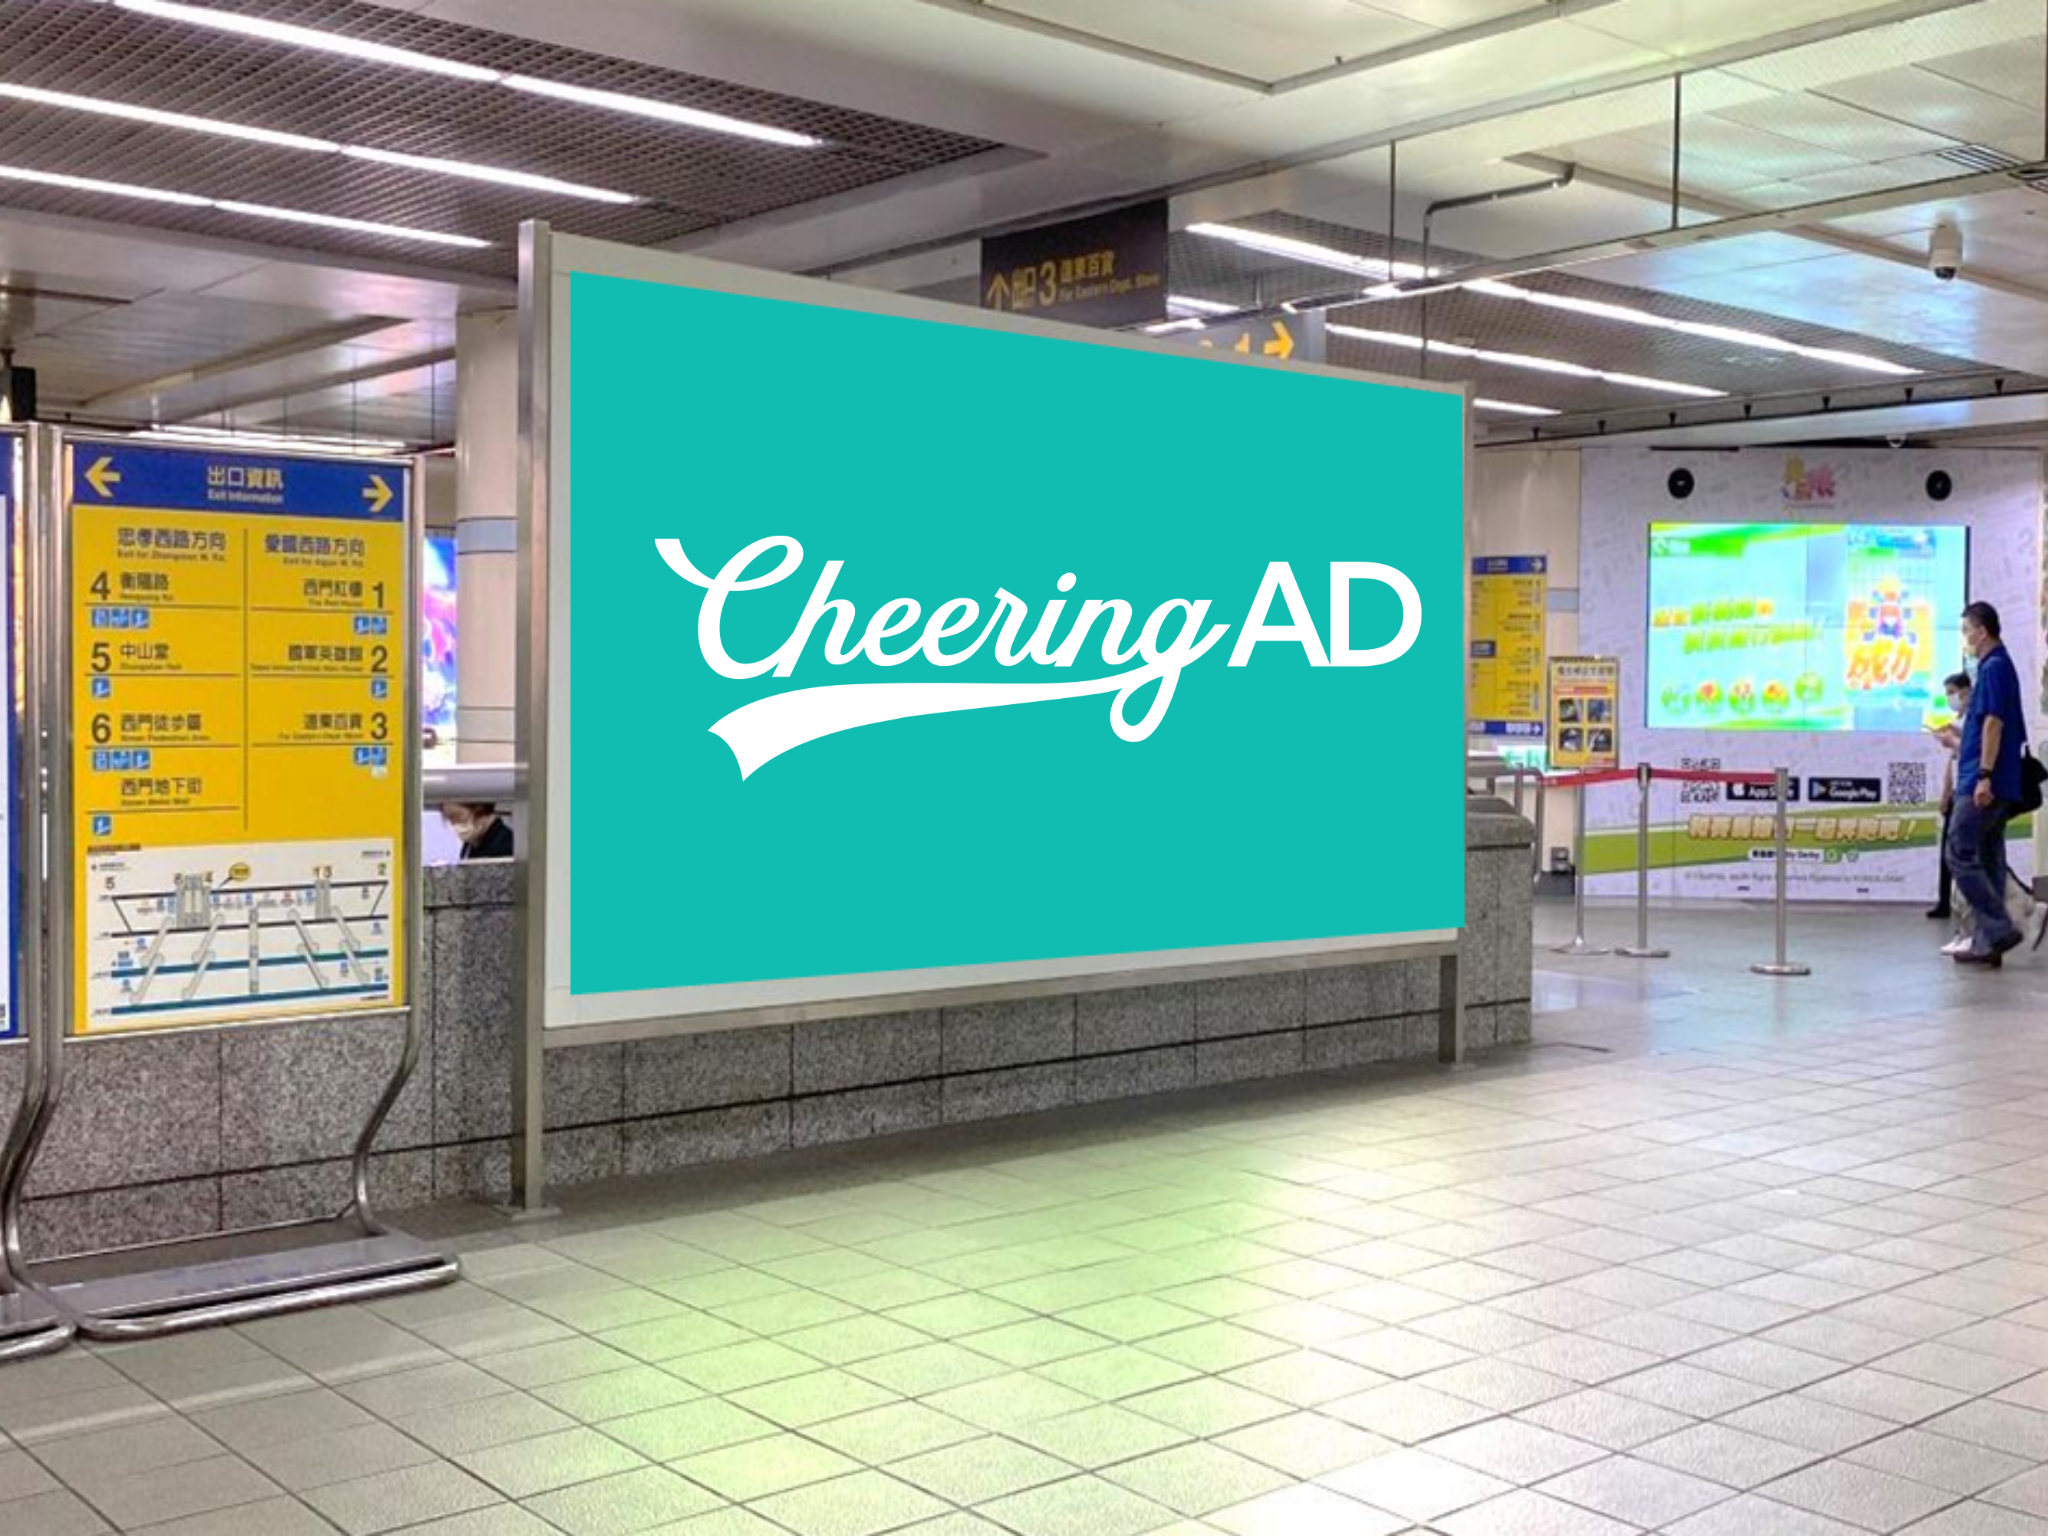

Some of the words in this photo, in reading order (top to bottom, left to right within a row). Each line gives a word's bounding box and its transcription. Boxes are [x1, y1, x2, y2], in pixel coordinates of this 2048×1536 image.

[1040, 262, 1056, 306] 3
[208, 466, 283, 490] 出口資訊
[91, 571, 111, 600] 4
[371, 582, 384, 609] 1
[121, 641, 169, 660] 中山堂
[655, 535, 1231, 743] Cheering
[1227, 561, 1422, 667] AD
[91, 642, 112, 673] 5
[370, 645, 388, 673] 2
[91, 713, 112, 744] 6
[370, 712, 388, 741] 3
